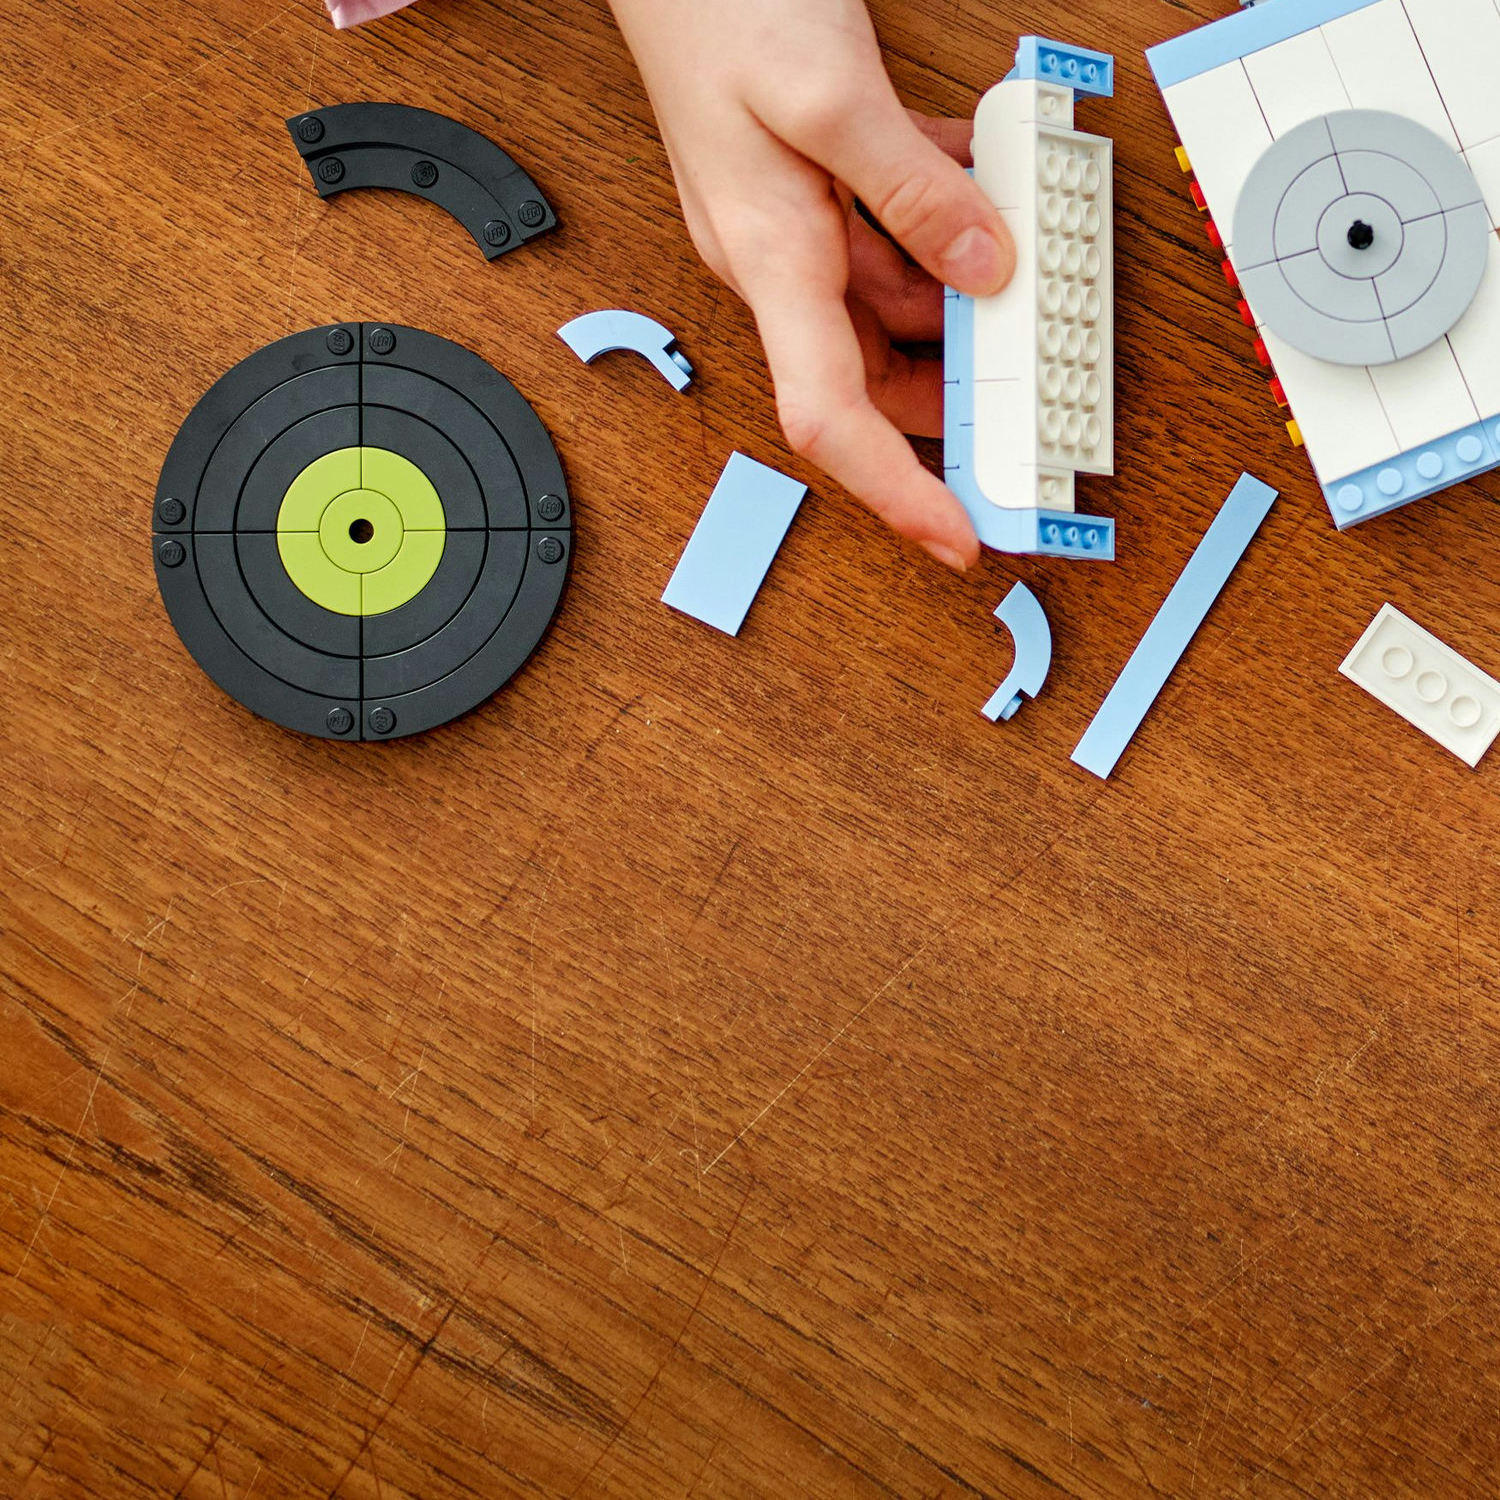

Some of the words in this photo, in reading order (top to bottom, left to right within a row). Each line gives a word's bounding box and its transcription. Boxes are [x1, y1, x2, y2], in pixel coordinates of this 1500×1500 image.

[322, 162, 340, 178] LEGO
[523, 205, 541, 222] LEGO
[488, 225, 506, 241] LEGO
[541, 501, 560, 513] LEGO
